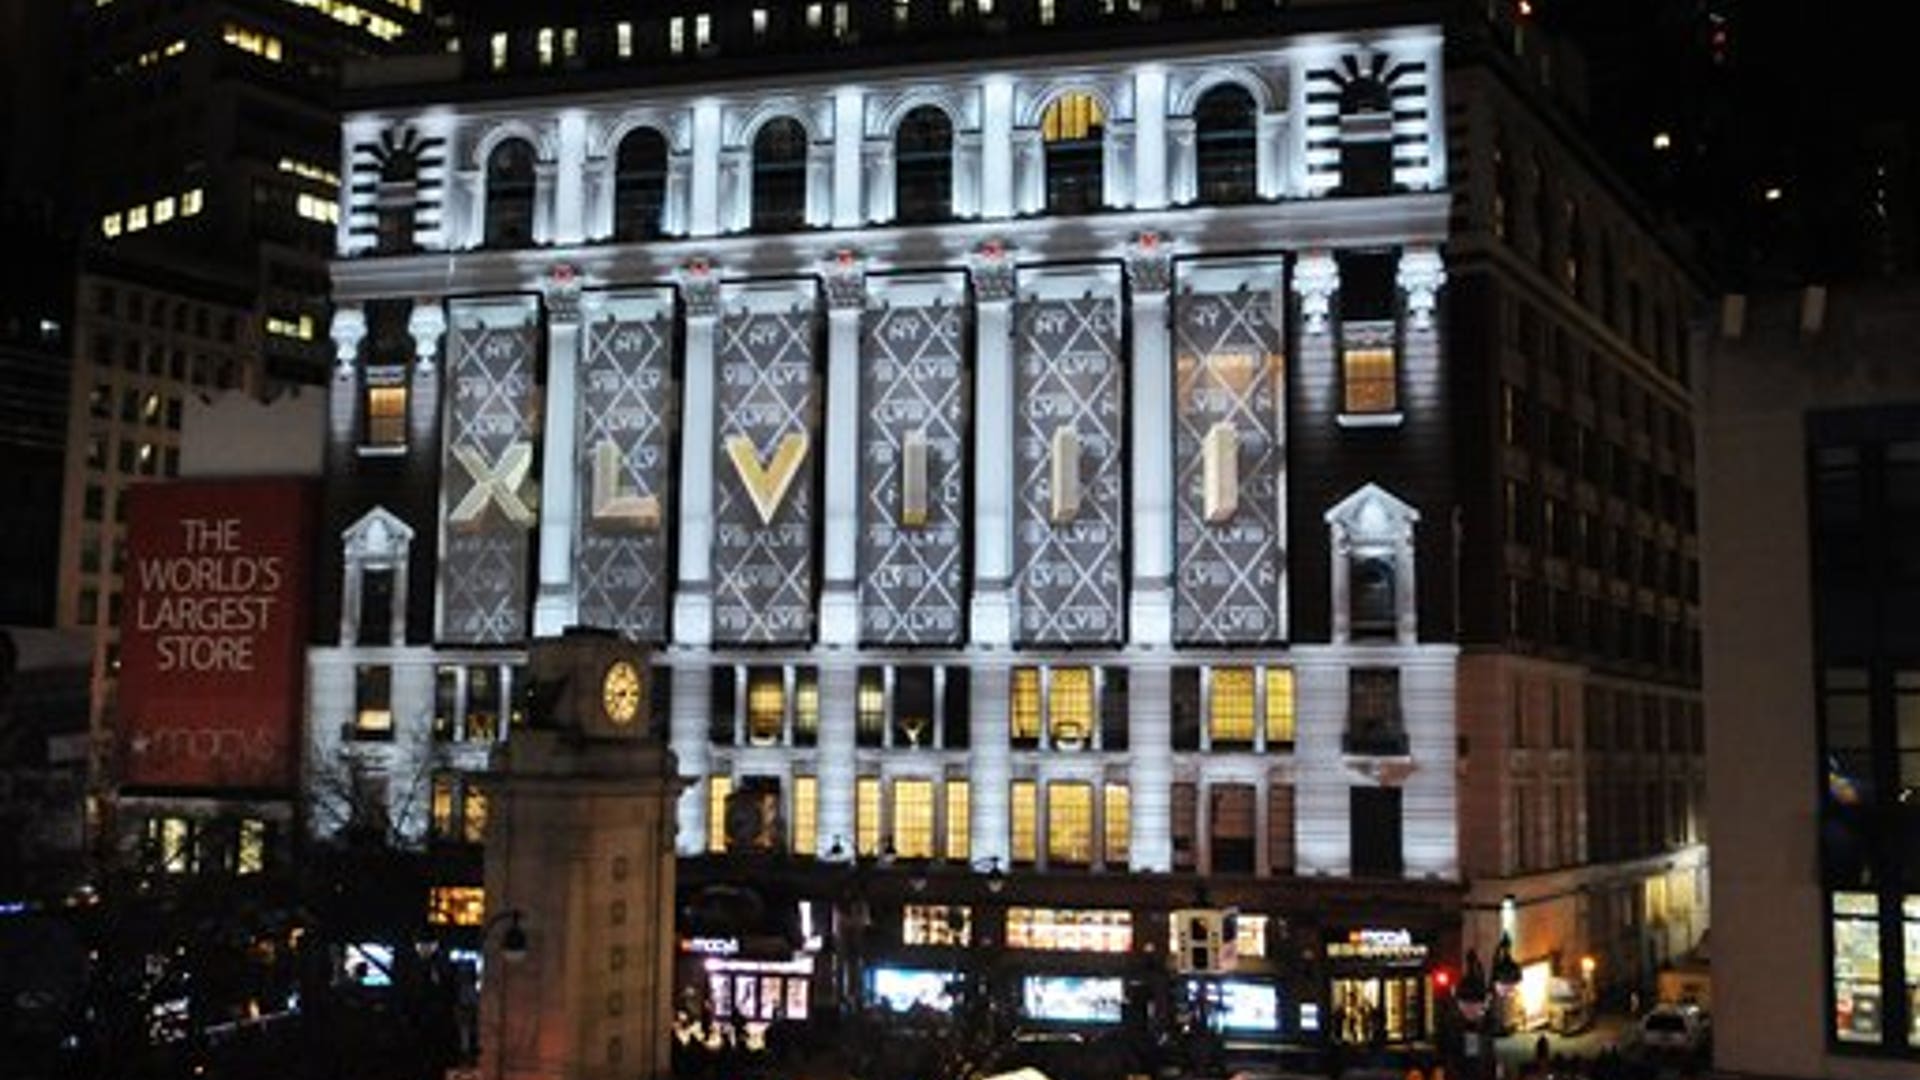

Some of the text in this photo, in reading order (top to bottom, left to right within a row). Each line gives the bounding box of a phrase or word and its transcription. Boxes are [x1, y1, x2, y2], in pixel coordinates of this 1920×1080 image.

[180, 518, 242, 551] THE
[139, 556, 283, 591] WORLD'S
[137, 597, 276, 630] LARGEST
[157, 635, 254, 671] STORE
